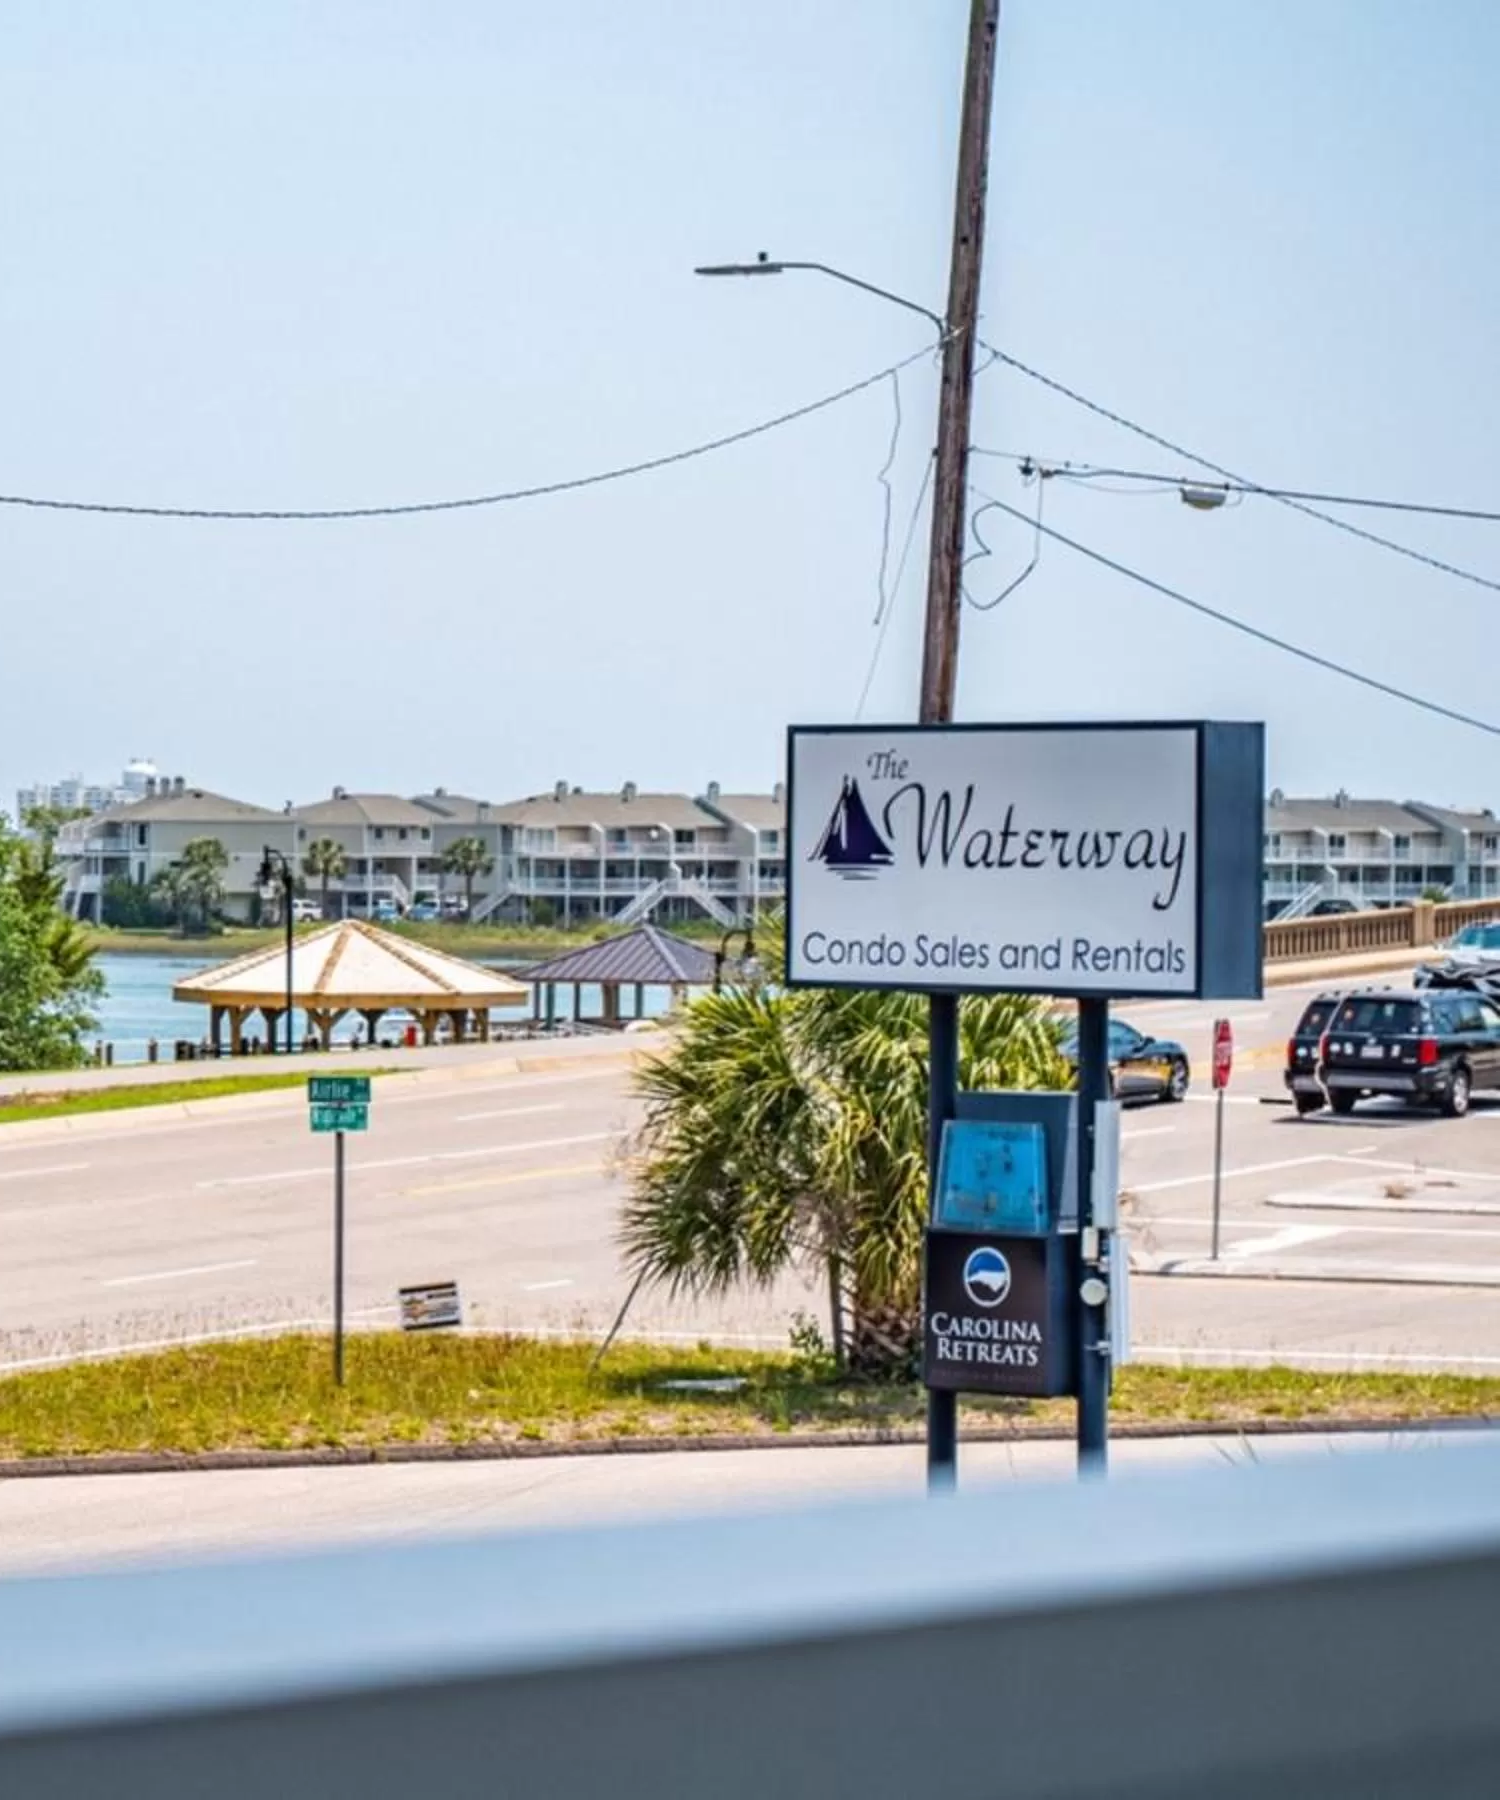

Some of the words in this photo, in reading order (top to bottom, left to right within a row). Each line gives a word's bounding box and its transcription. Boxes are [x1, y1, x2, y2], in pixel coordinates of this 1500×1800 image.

[866, 747, 910, 780] The
[882, 780, 1188, 912] Waterway
[802, 931, 906, 967] Condo
[914, 934, 990, 969] Sales
[999, 936, 1062, 971] and
[1071, 938, 1186, 974] Rentals
[930, 1311, 1042, 1343] CAROLINA
[937, 1337, 1039, 1366] RETREATS
